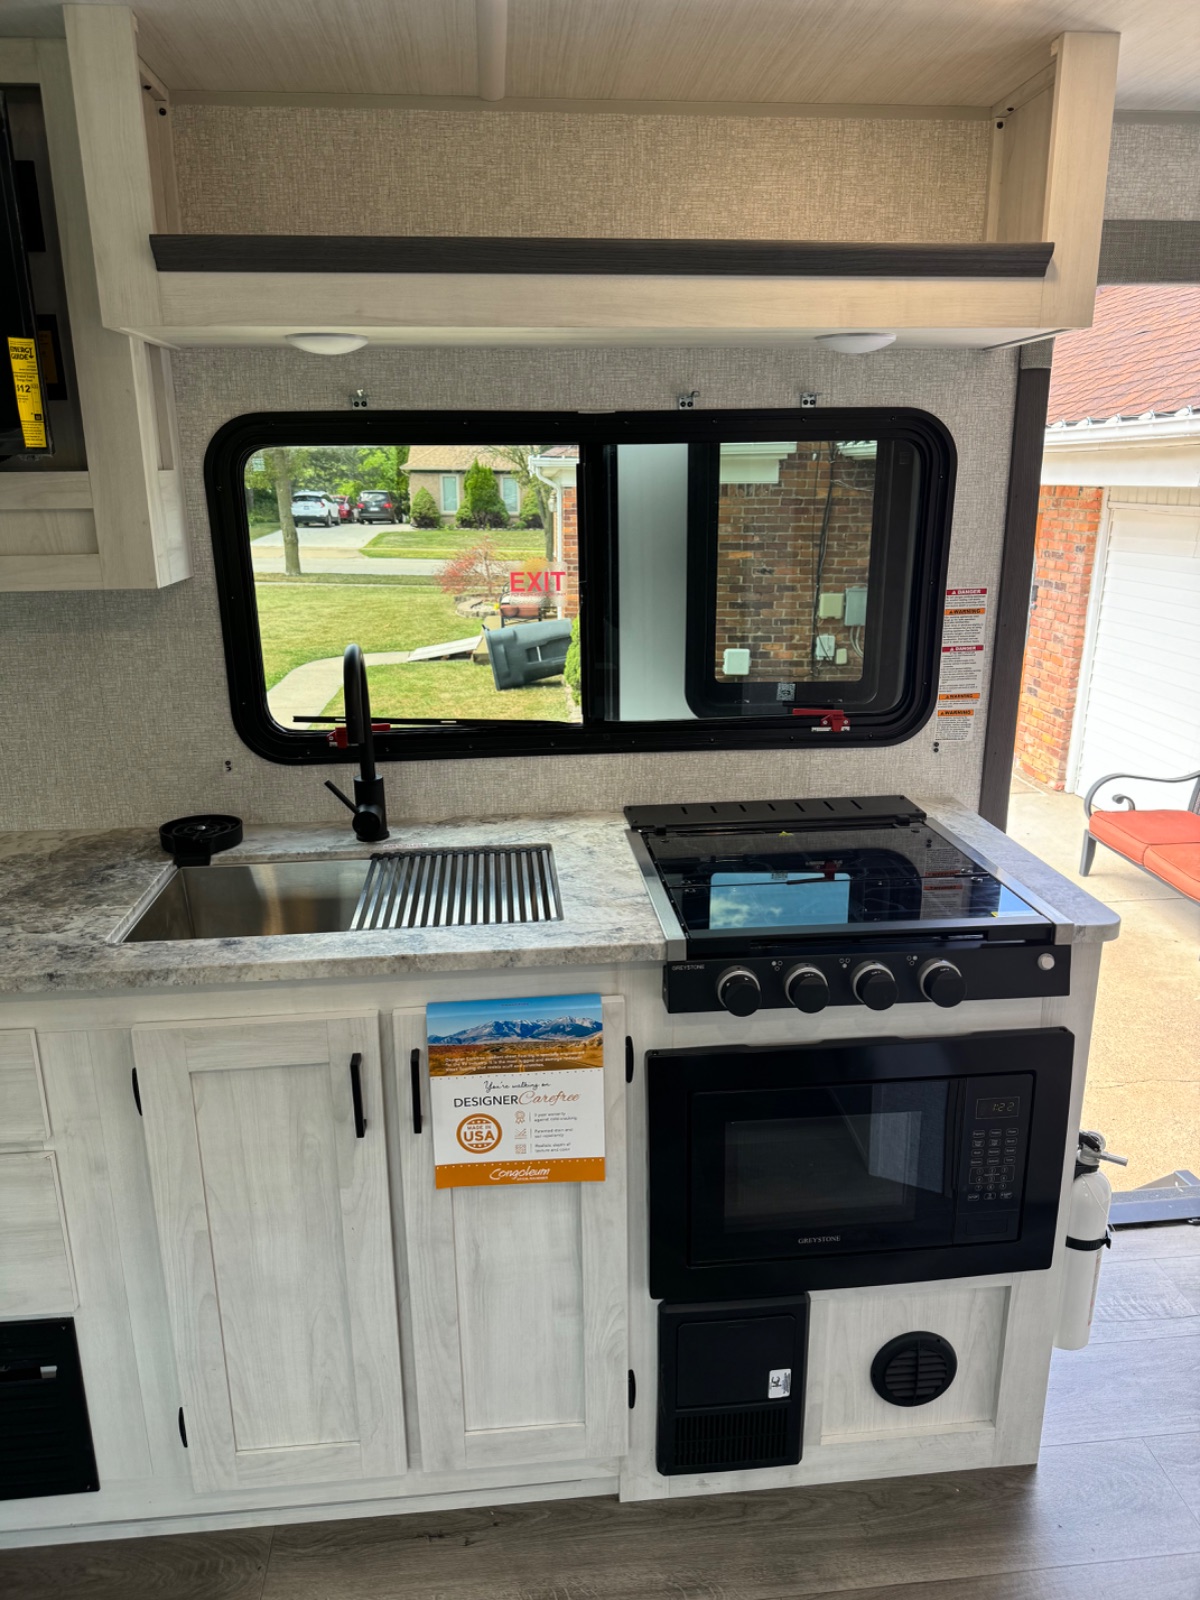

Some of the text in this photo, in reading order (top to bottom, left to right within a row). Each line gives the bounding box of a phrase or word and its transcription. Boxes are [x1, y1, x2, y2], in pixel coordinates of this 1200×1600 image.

[510, 571, 566, 592] EXIT
[463, 1130, 495, 1142] USA
[489, 1165, 551, 1181] Congoleum
[797, 1235, 841, 1244] GREYSTONE
